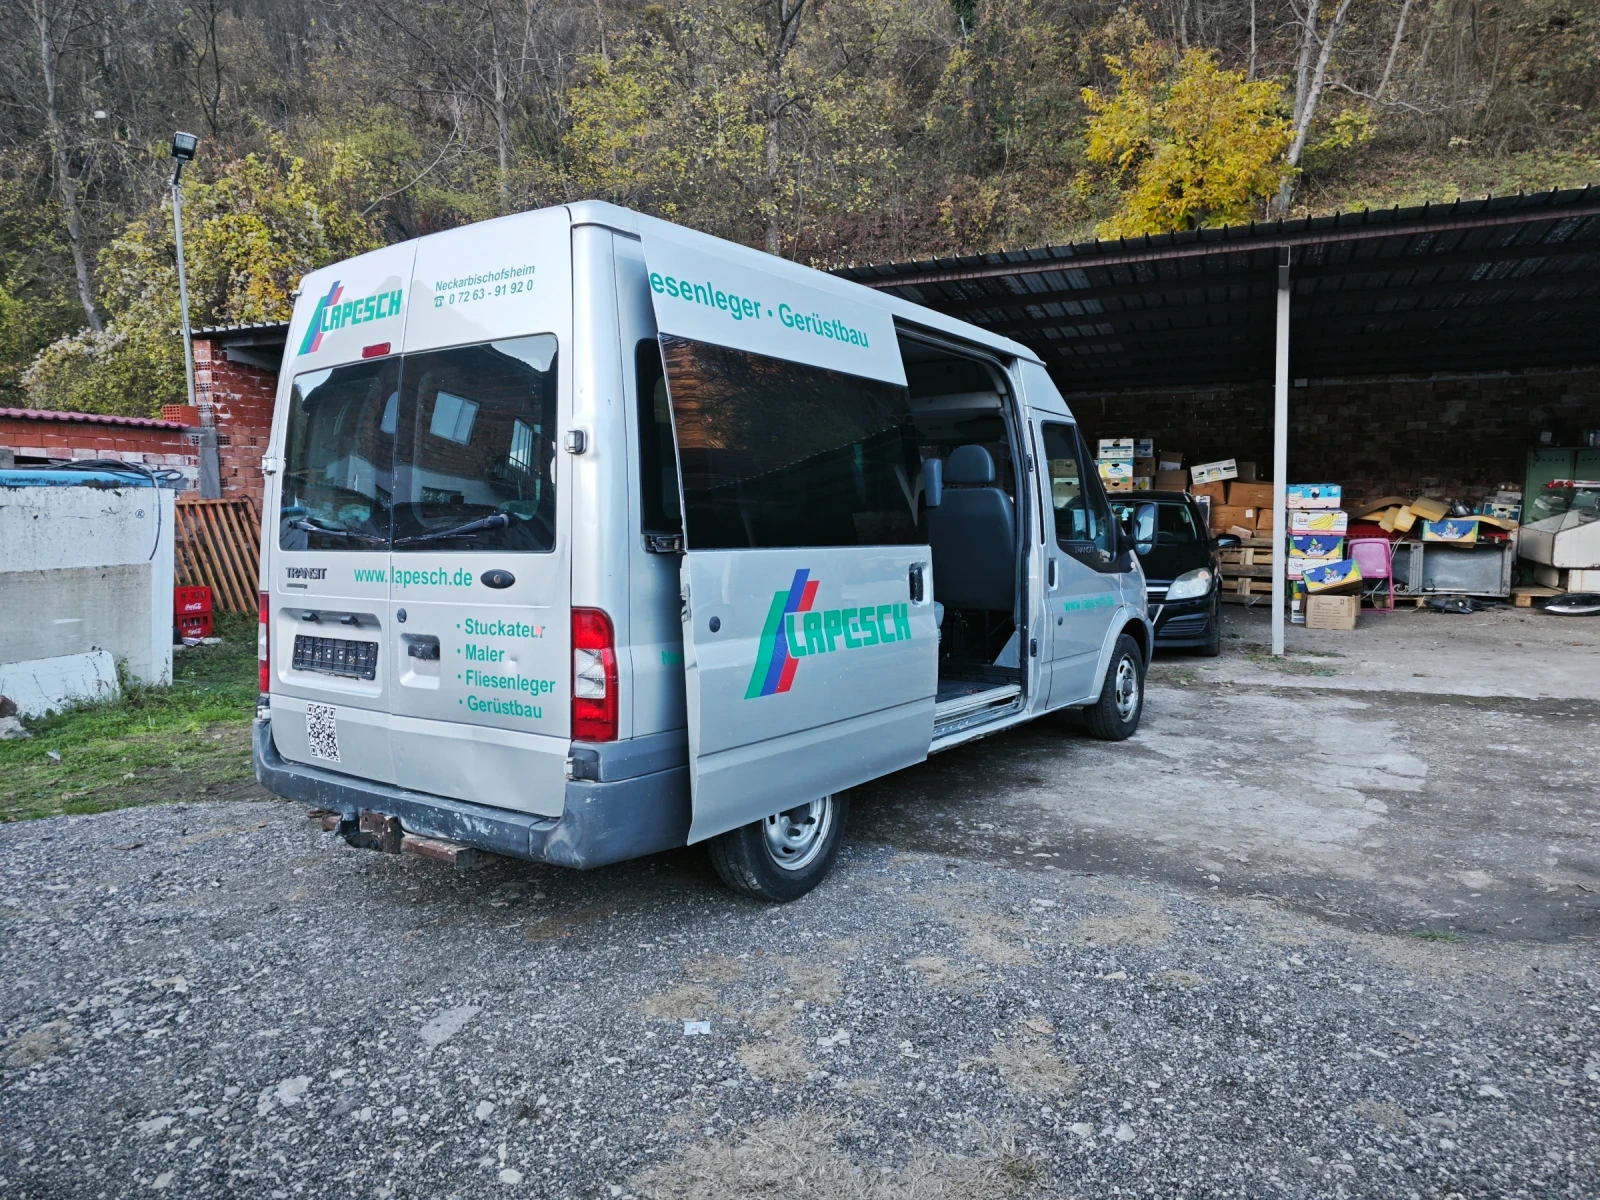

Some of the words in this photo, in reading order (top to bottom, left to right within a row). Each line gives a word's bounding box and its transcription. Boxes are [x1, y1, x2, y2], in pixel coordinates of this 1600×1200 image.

[435, 264, 535, 292] Neckarbischofsheim
[449, 294, 455, 305] 0
[458, 291, 470, 303] 72
[472, 288, 485, 301] 63
[494, 284, 507, 297] 91
[510, 281, 524, 294] 92
[526, 279, 533, 291] 0
[320, 289, 403, 333] LAPESCH
[778, 303, 870, 348] Gerüstbau
[285, 567, 327, 580] TRANSIT
[354, 566, 473, 588] www.lapesch.de
[465, 618, 546, 639] Stuckateur
[785, 603, 912, 658] LAPESCH
[465, 644, 505, 662] Maler
[465, 669, 556, 697] Fliesenleger
[467, 695, 542, 719] Gerüstbau
